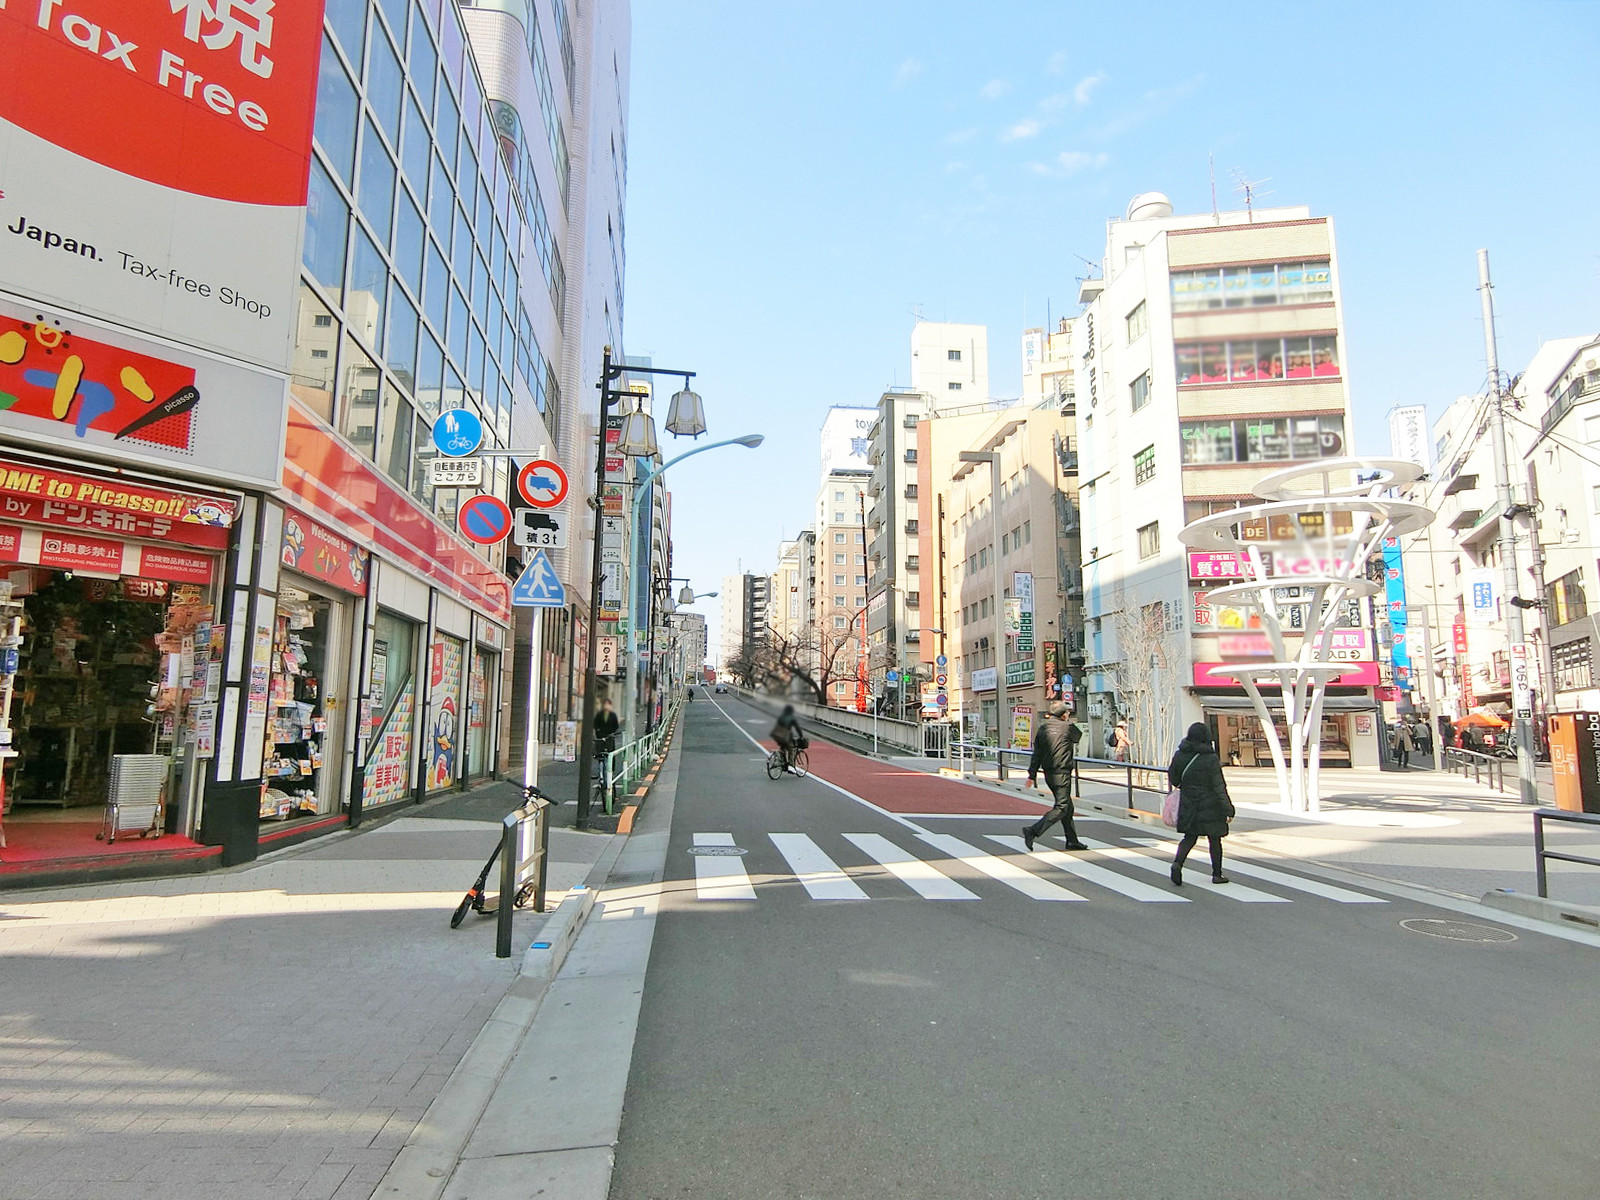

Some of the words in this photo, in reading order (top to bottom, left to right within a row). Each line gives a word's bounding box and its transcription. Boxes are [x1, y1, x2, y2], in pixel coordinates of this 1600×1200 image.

[37, 0, 139, 74] Tax
[158, 49, 269, 131] Free
[7, 216, 104, 262] Japan.
[117, 250, 212, 298] Tax-free
[218, 287, 272, 320] Shop
[163, 391, 196, 413] picasso
[434, 461, 478, 471] 自転車通行可
[434, 472, 476, 482] ここから
[6, 497, 31, 517] by
[47, 479, 73, 499] to
[76, 483, 186, 518] Picasso!!
[311, 522, 340, 549] Welcome
[340, 540, 348, 553] to
[1246, 527, 1265, 538] DE
[61, 542, 120, 559] 撮影禁止
[1193, 591, 1211, 625] 買取
[1313, 650, 1347, 660] 2入口
